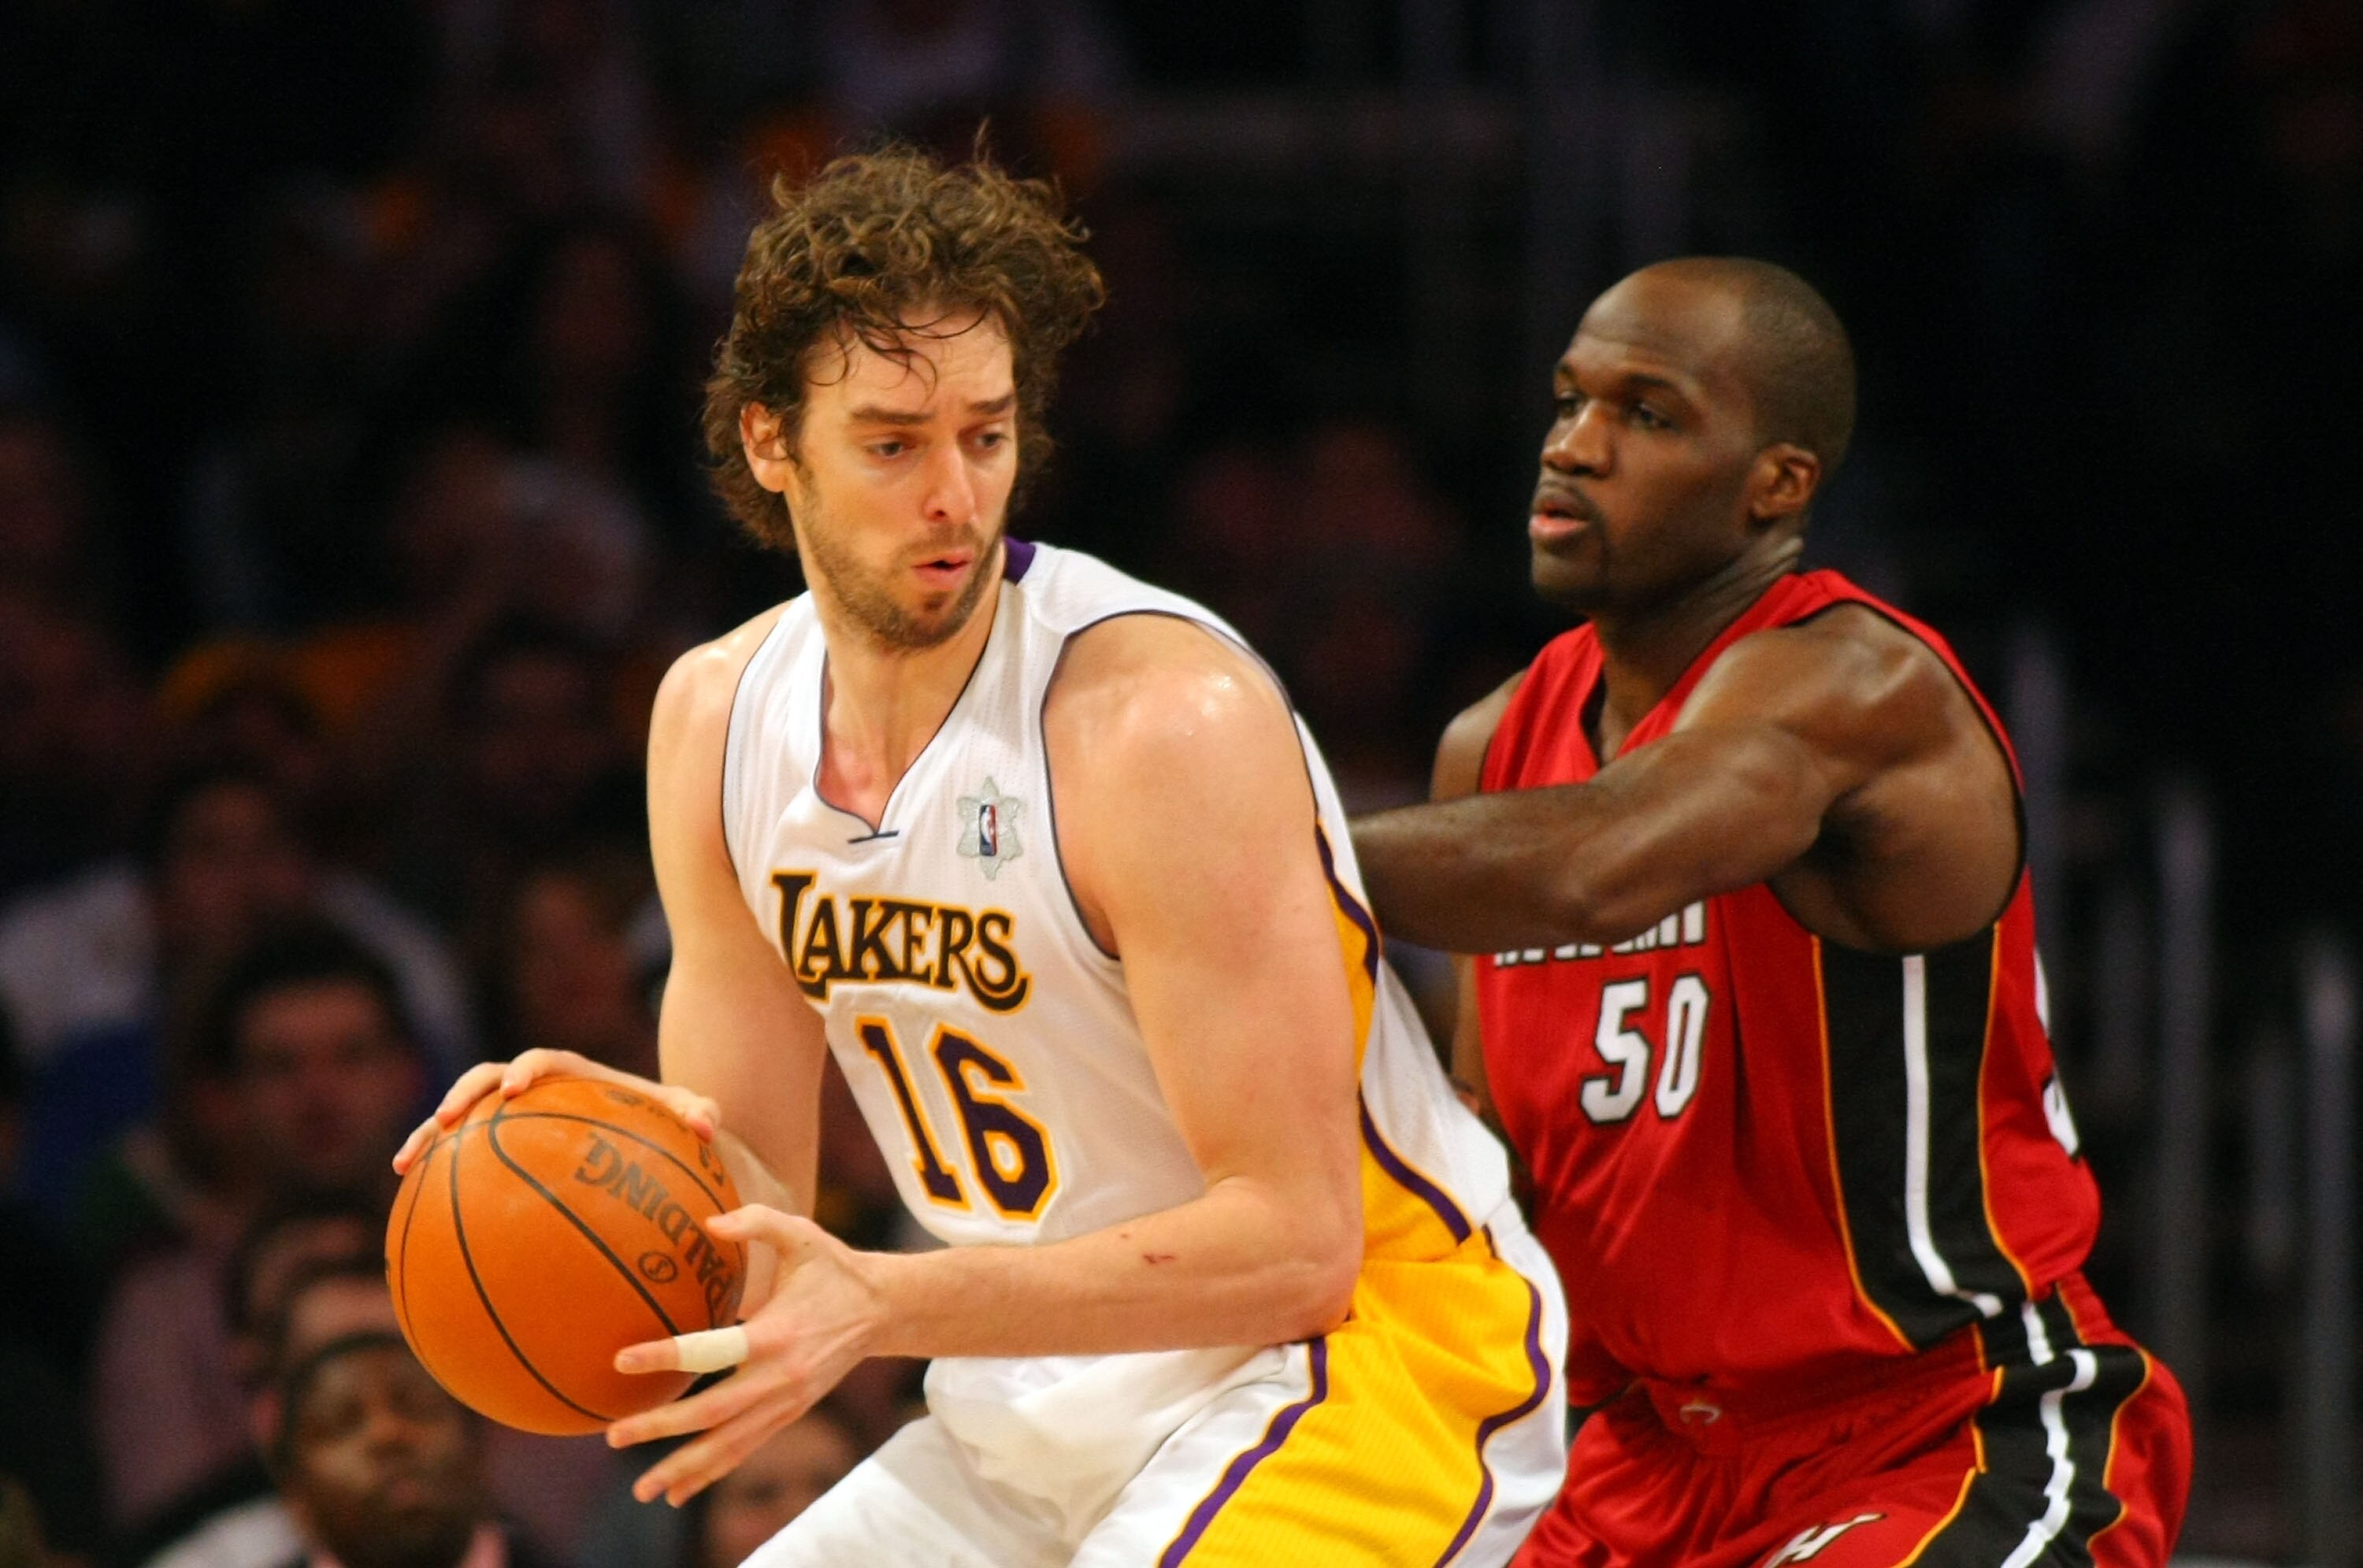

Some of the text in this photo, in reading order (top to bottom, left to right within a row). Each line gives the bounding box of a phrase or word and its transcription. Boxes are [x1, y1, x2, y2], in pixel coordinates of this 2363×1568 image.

[770, 869, 1031, 1015] LAKERS
[855, 1016, 1059, 1222] 16
[1580, 973, 1710, 1125] 50
[575, 1139, 734, 1329] PALDING
